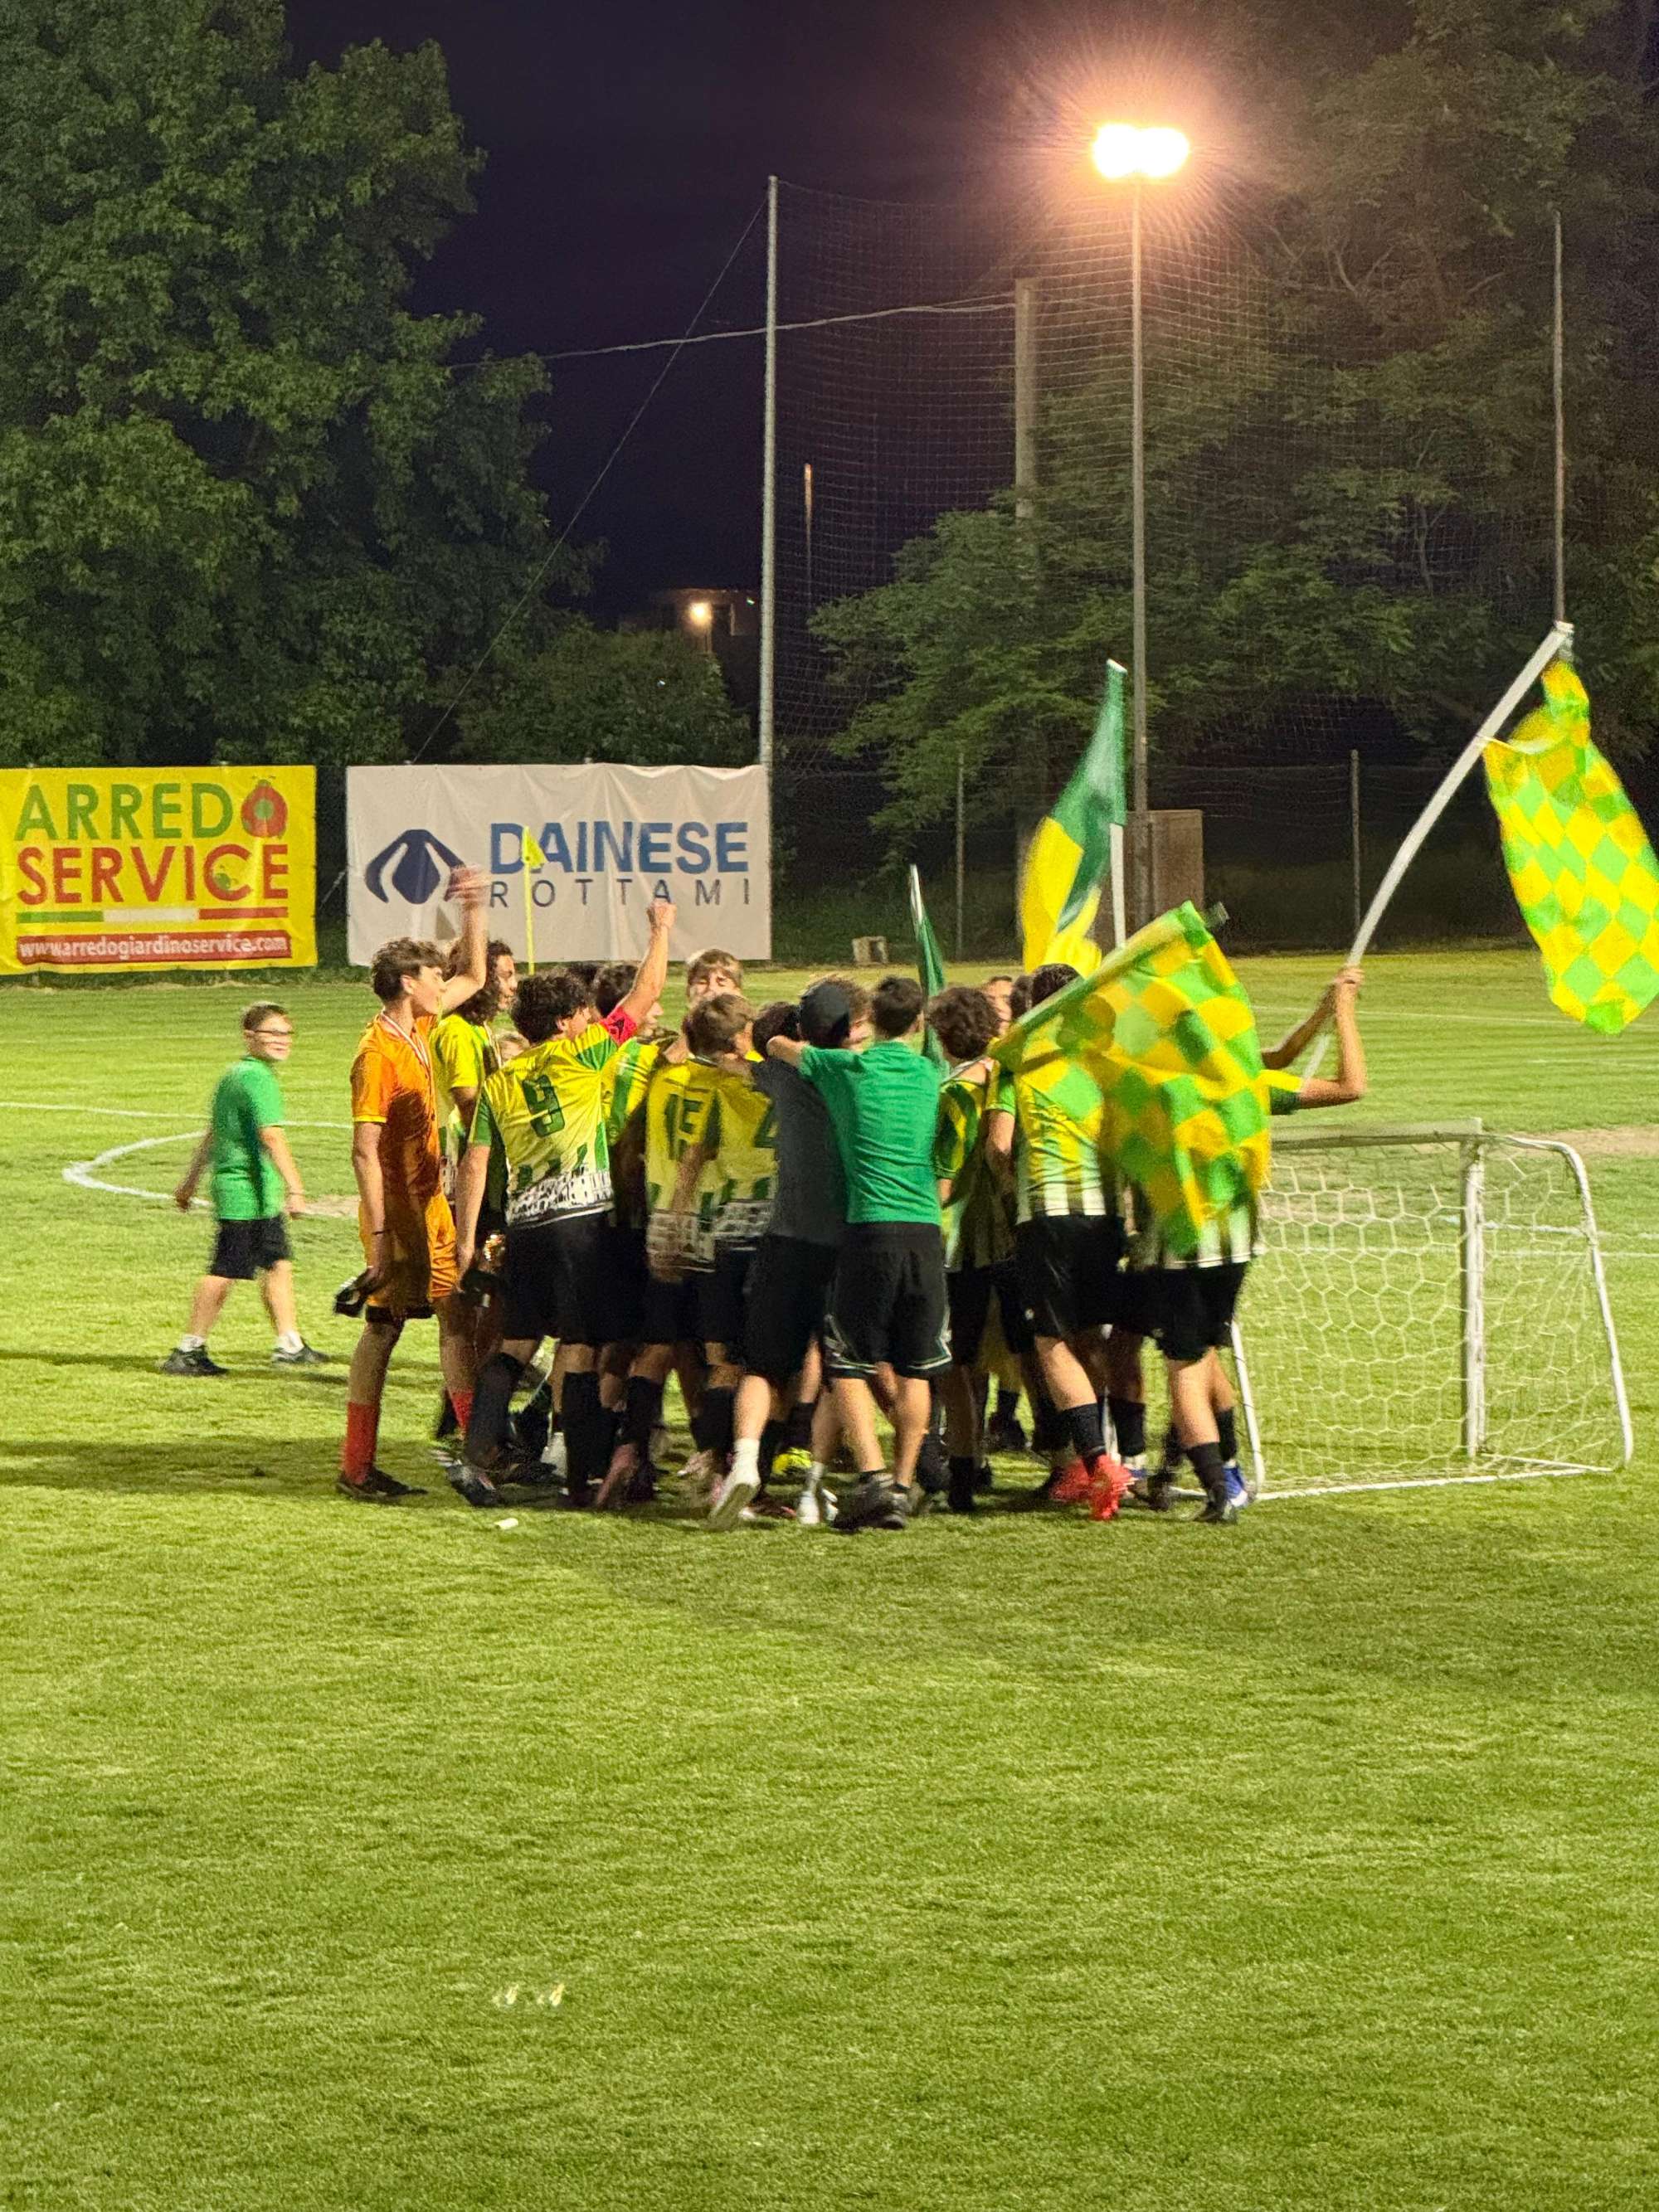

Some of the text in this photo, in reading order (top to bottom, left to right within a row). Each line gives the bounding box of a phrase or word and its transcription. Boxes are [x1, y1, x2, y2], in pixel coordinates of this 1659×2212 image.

[17, 843, 289, 905] SERVICE
[490, 821, 749, 874] DAINESE
[489, 878, 750, 908] ROTTAMI
[522, 1074, 566, 1137] 9
